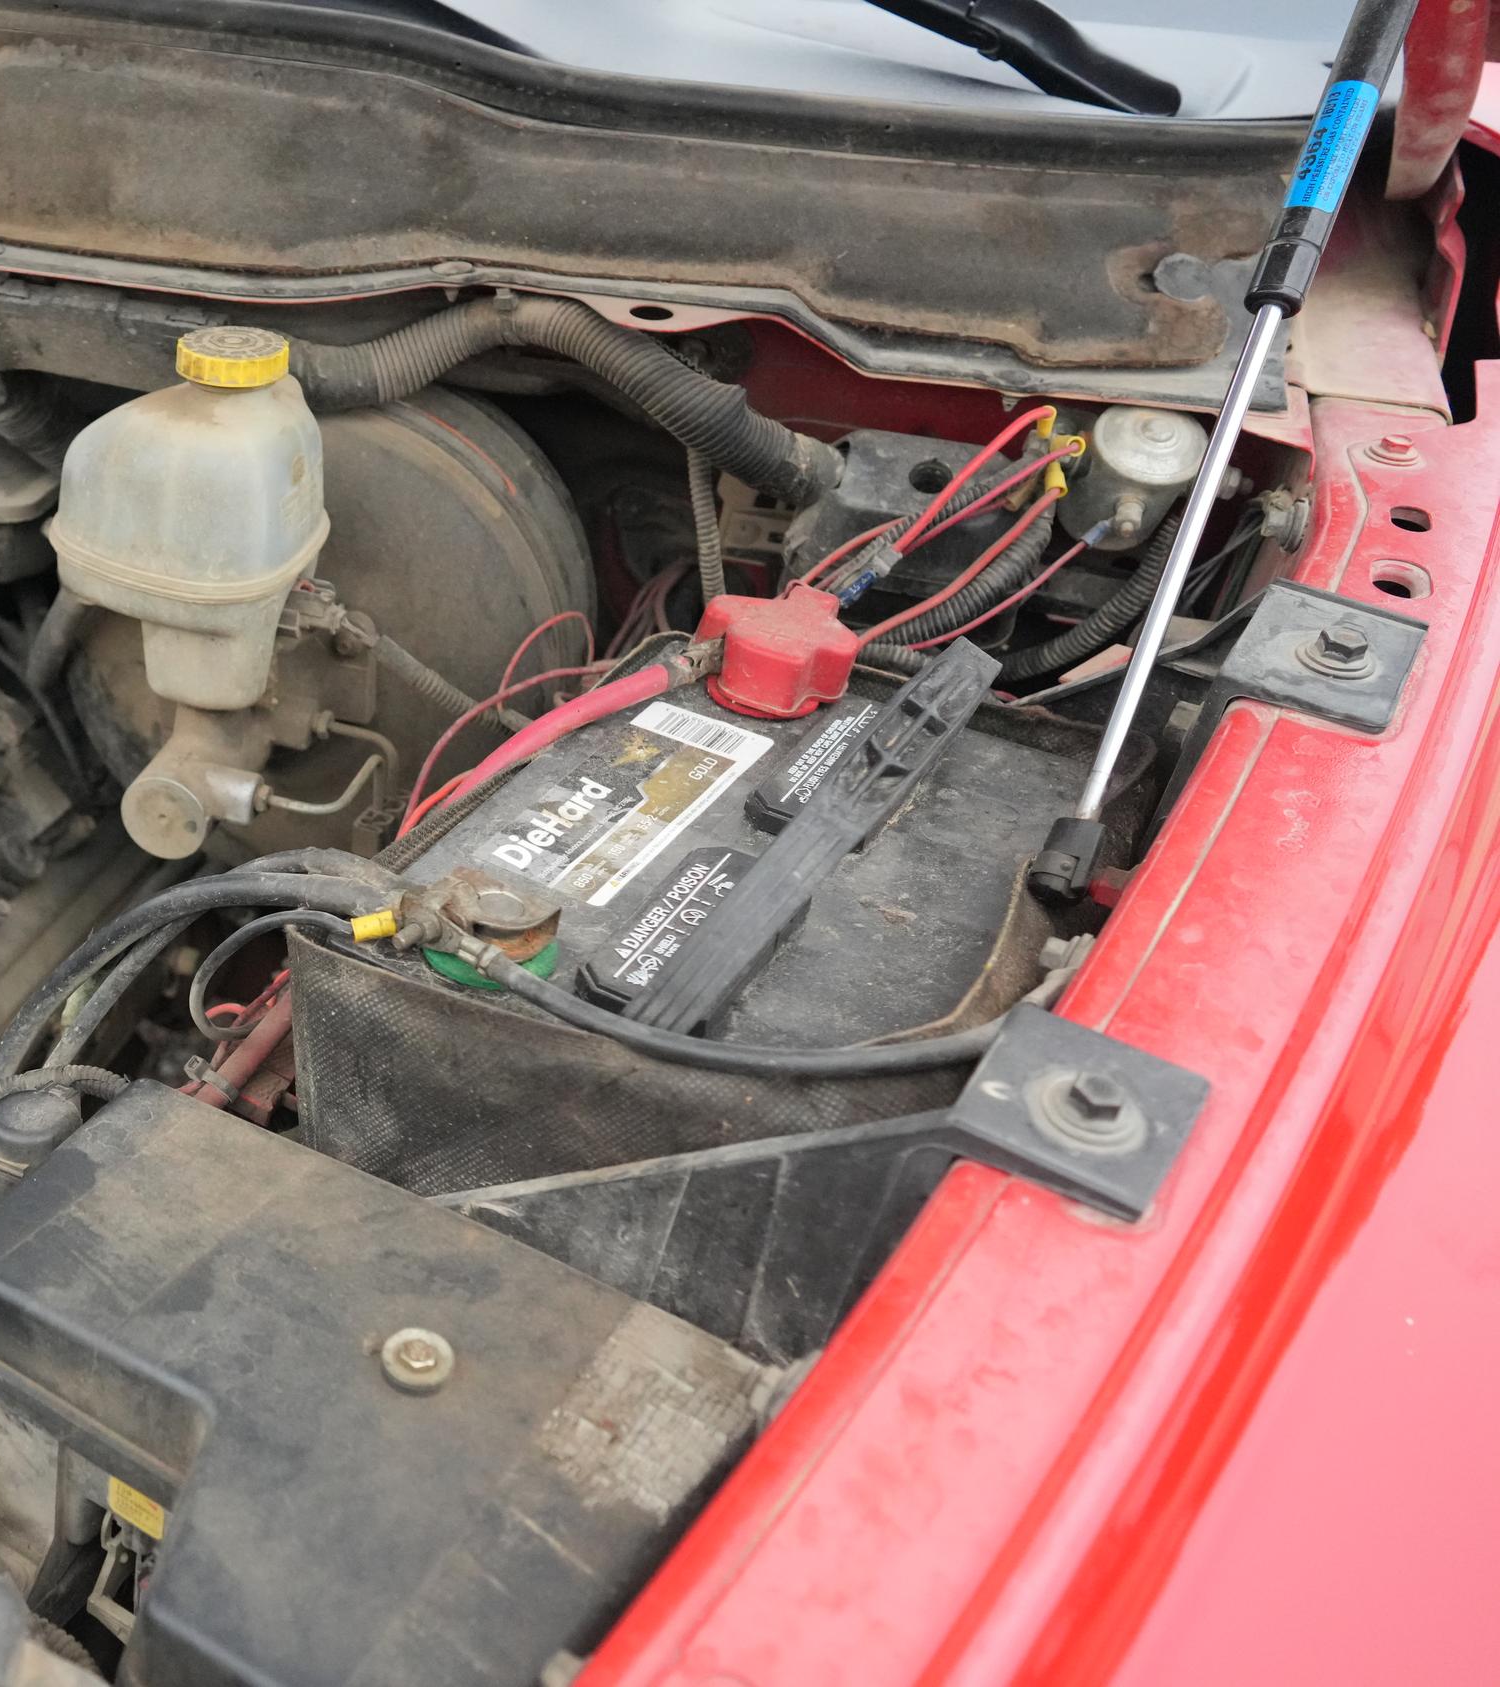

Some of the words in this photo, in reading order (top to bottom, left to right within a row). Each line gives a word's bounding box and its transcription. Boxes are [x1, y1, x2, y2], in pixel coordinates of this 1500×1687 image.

[1302, 182, 1316, 203] HIGH
[1312, 149, 1331, 184] PRESSURE
[1326, 132, 1338, 148] GAS
[1332, 87, 1355, 130] CONTAINED
[688, 757, 718, 780] GOLD
[803, 776, 820, 788] FLUSH
[815, 765, 830, 776] EYES
[492, 776, 613, 870] DieHard
[573, 873, 594, 889] 850
[666, 863, 711, 901] POISON
[662, 898, 674, 909] /
[621, 907, 671, 949] DANGER
[653, 934, 676, 954] SHIELD
